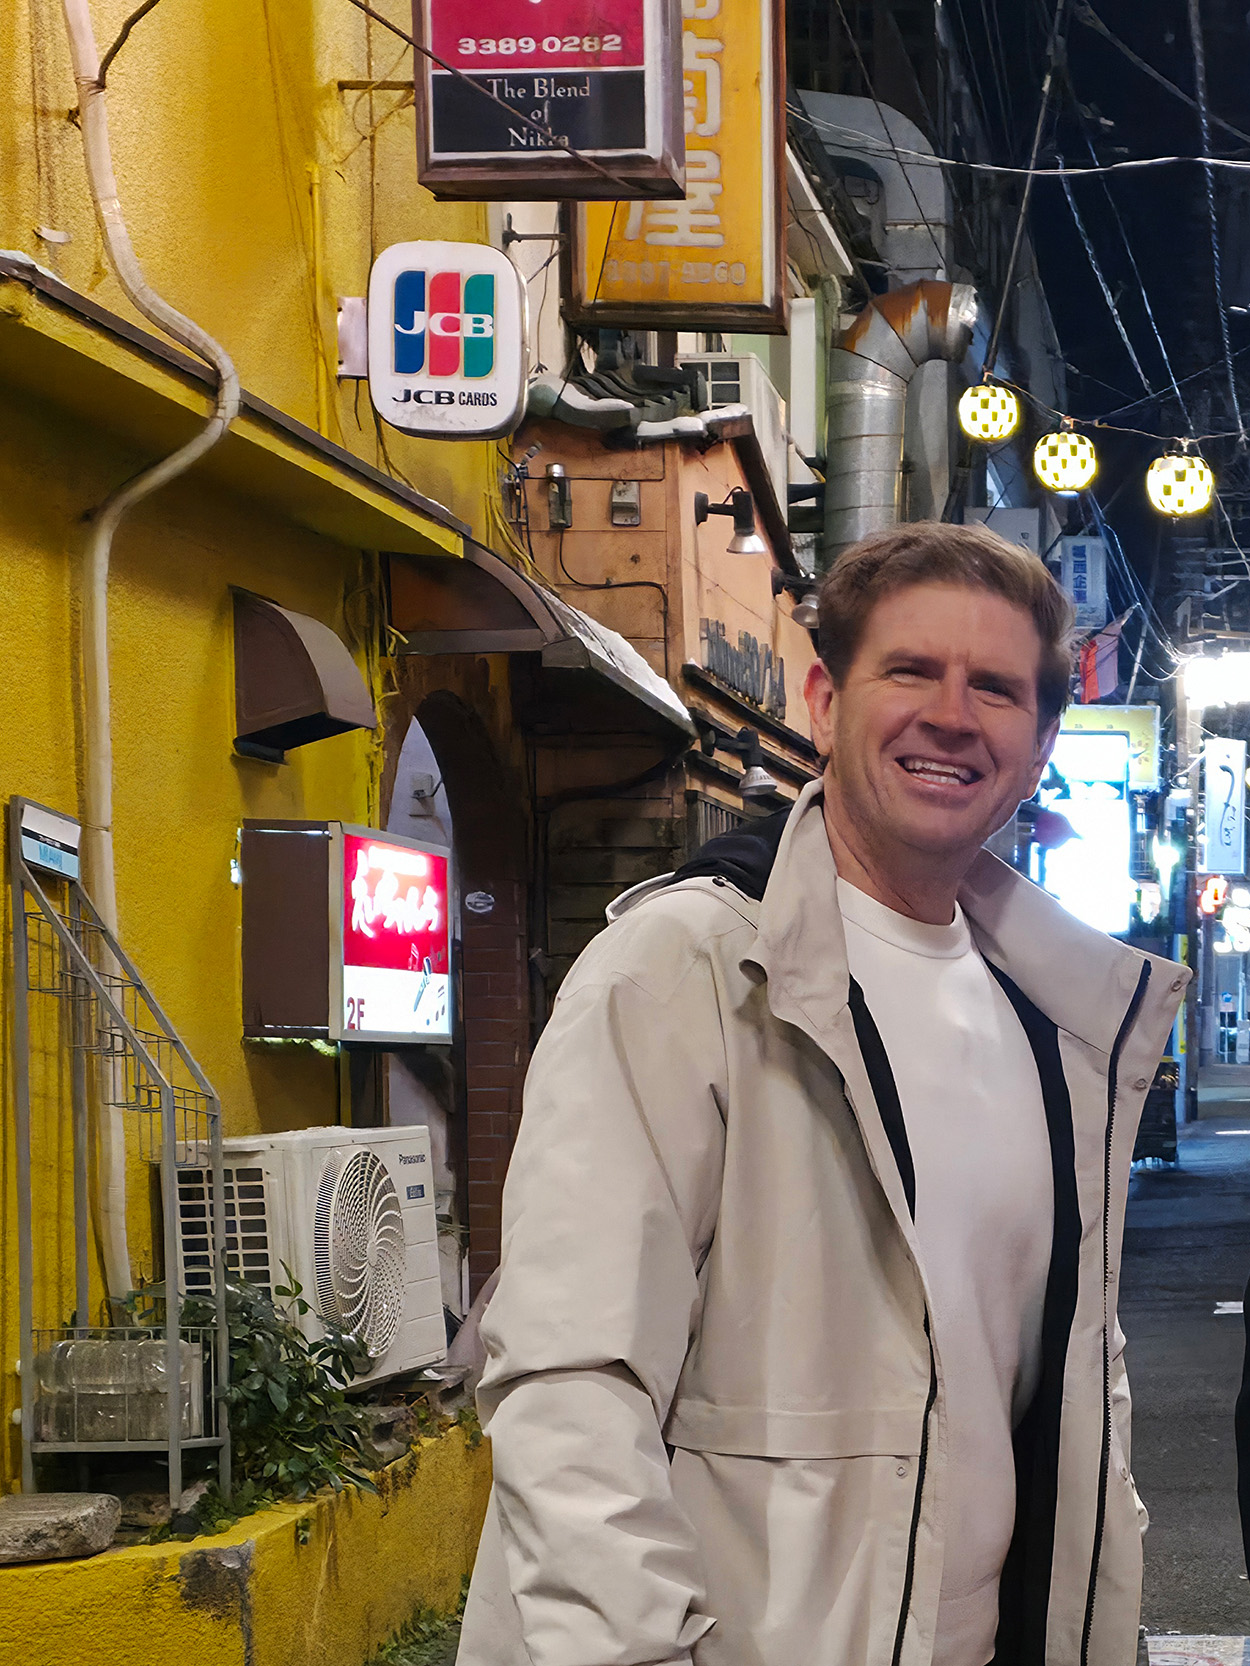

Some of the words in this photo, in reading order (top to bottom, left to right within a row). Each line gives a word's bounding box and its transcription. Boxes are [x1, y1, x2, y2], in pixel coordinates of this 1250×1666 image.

[487, 78, 526, 98] The
[534, 76, 590, 98] Blend
[530, 100, 549, 123] of
[508, 127, 569, 147] Nikka
[394, 311, 494, 338] JCB
[392, 389, 455, 405] JCB
[458, 391, 498, 407] CARDS
[346, 997, 365, 1030] 2F
